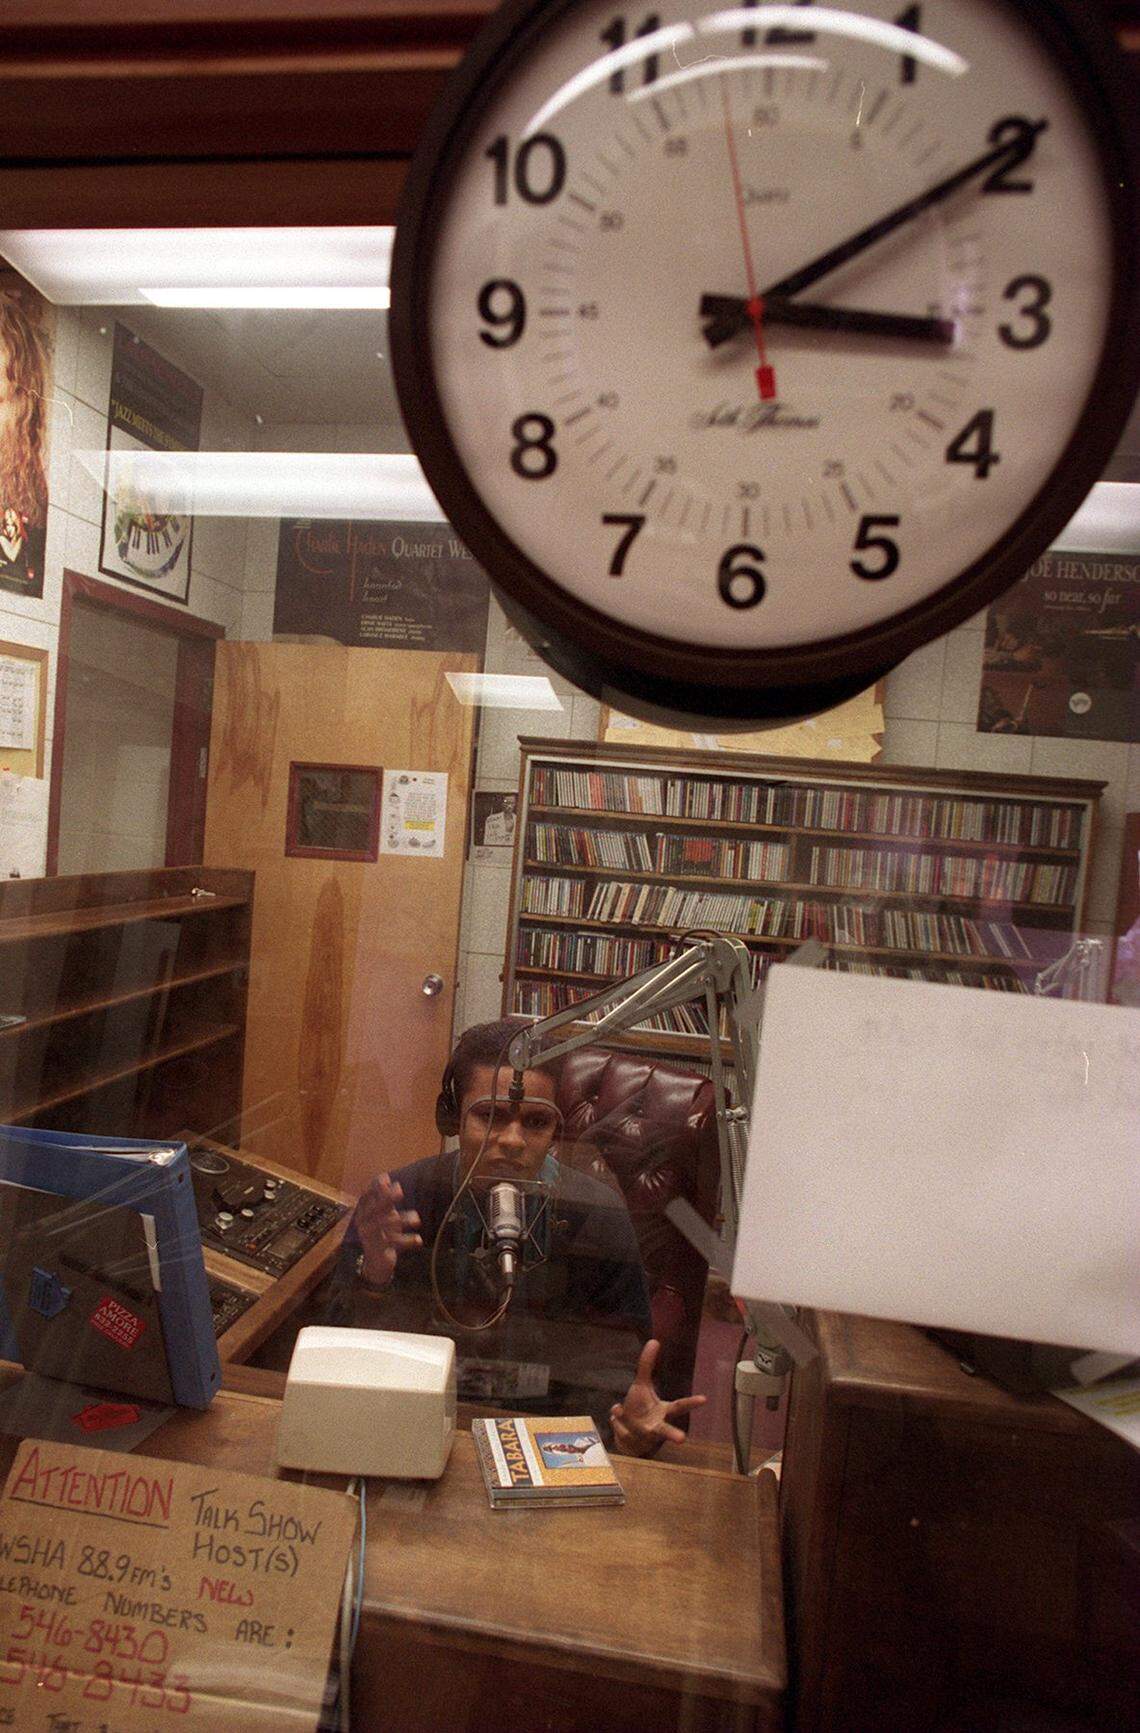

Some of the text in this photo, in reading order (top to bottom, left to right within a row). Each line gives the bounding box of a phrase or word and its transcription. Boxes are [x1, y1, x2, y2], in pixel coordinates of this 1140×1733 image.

[484, 131, 567, 207] 10
[982, 115, 1036, 194] 2
[477, 277, 527, 350] 9
[997, 273, 1052, 350] 3
[509, 411, 559, 482] 8
[945, 407, 1000, 480] 4
[448, 539, 474, 561] WES
[602, 514, 646, 577] 7
[717, 543, 767, 611] 6
[850, 513, 901, 582] 5
[99, 1306, 140, 1338] AMORE
[108, 1301, 138, 1327] PIZZA
[496, 1419, 530, 1483] TABARA
[11, 1447, 174, 1521] ATTENTION
[191, 1488, 323, 1545] TALK SHOW
[193, 1535, 299, 1577] HOST(S)
[103, 1592, 208, 1633] NUMBERS
[198, 1577, 254, 1606] NEW
[11, 1605, 170, 1664] 546-8430
